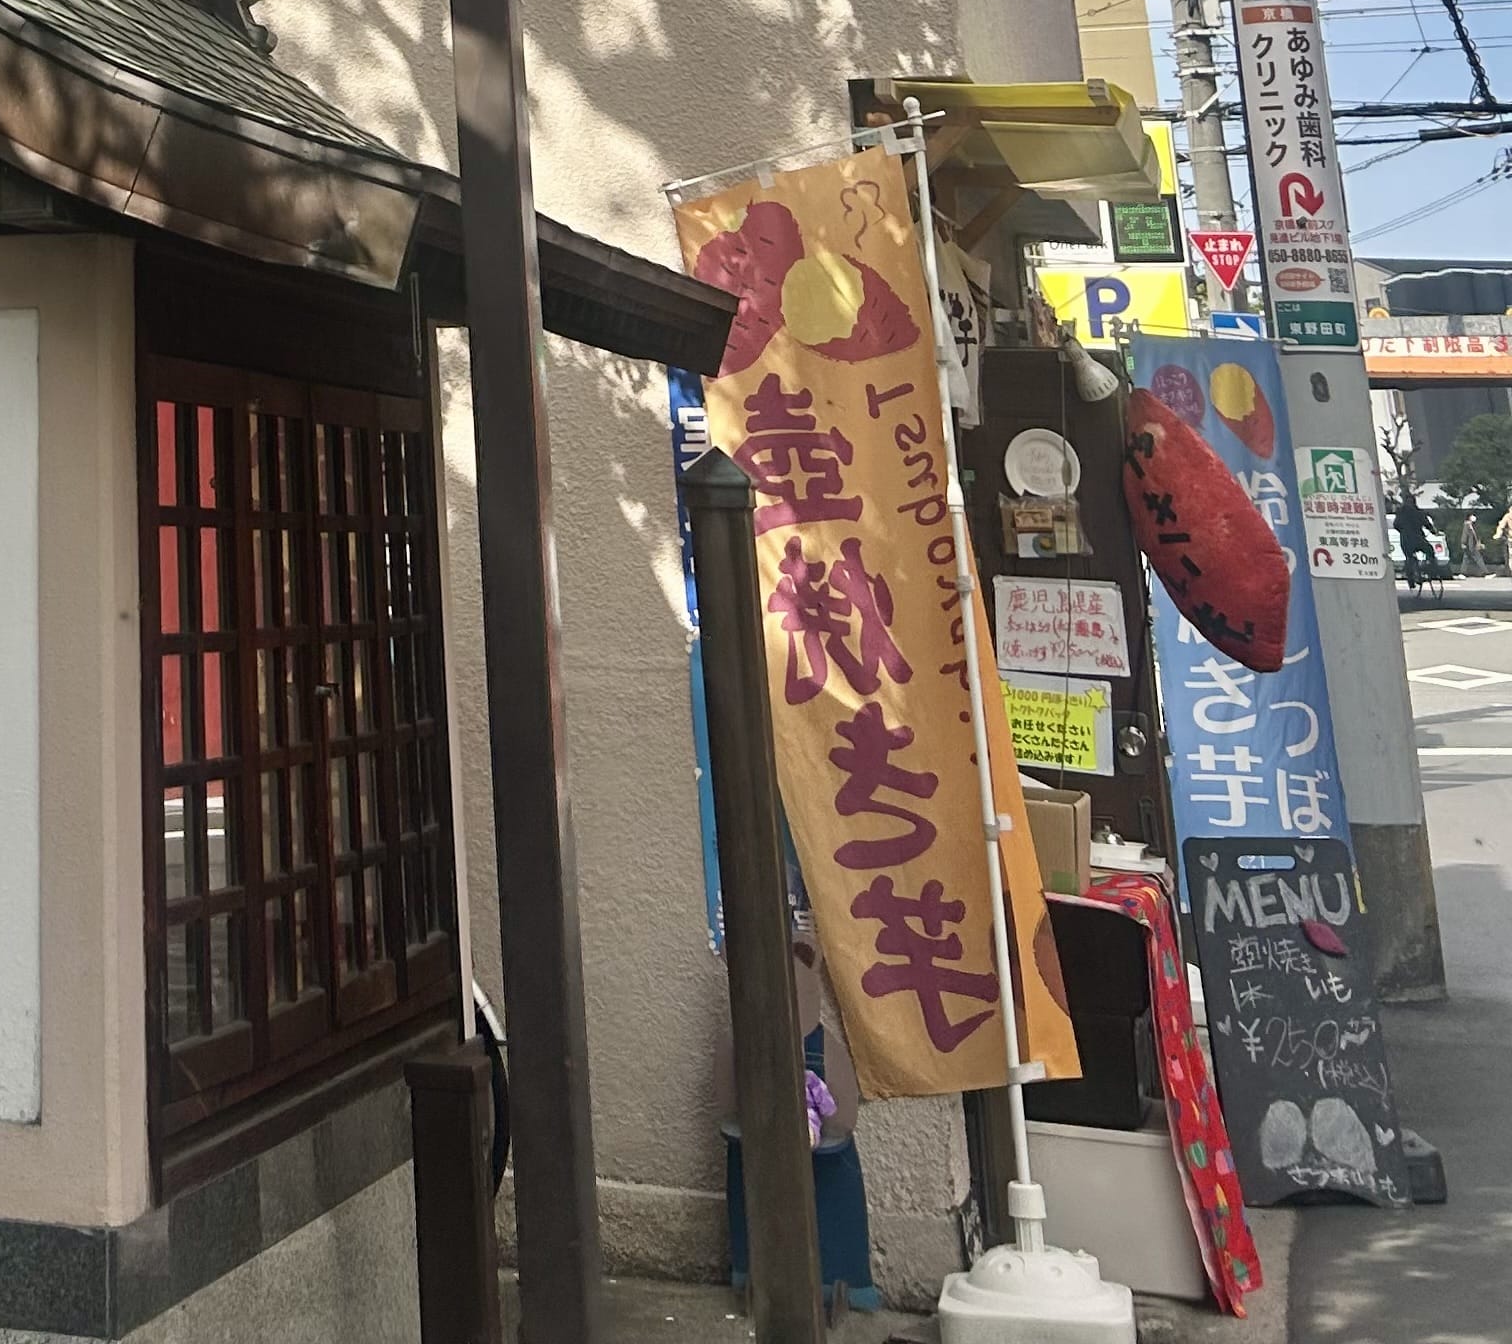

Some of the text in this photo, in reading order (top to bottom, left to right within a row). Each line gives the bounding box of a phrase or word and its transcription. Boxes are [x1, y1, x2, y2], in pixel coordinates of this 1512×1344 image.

[1262, 6, 1294, 21] 京橋
[1251, 33, 1288, 168] クリニック
[1286, 27, 1326, 169] あゆみ歯科
[1273, 218, 1335, 231] 京橋前スグ
[1204, 238, 1244, 253] 止まれ
[1211, 253, 1241, 267] STOP
[1084, 276, 1131, 339] P
[1290, 321, 1346, 337] 東野田町
[1342, 552, 1379, 566] 320m
[1007, 586, 1106, 615] 鹿児島県産
[1011, 718, 1092, 737] お任せください
[1177, 614, 1270, 828] き芋
[1012, 732, 1090, 752] たくさんたくさん
[1204, 872, 1351, 934] MENU
[1304, 971, 1352, 1004] いも
